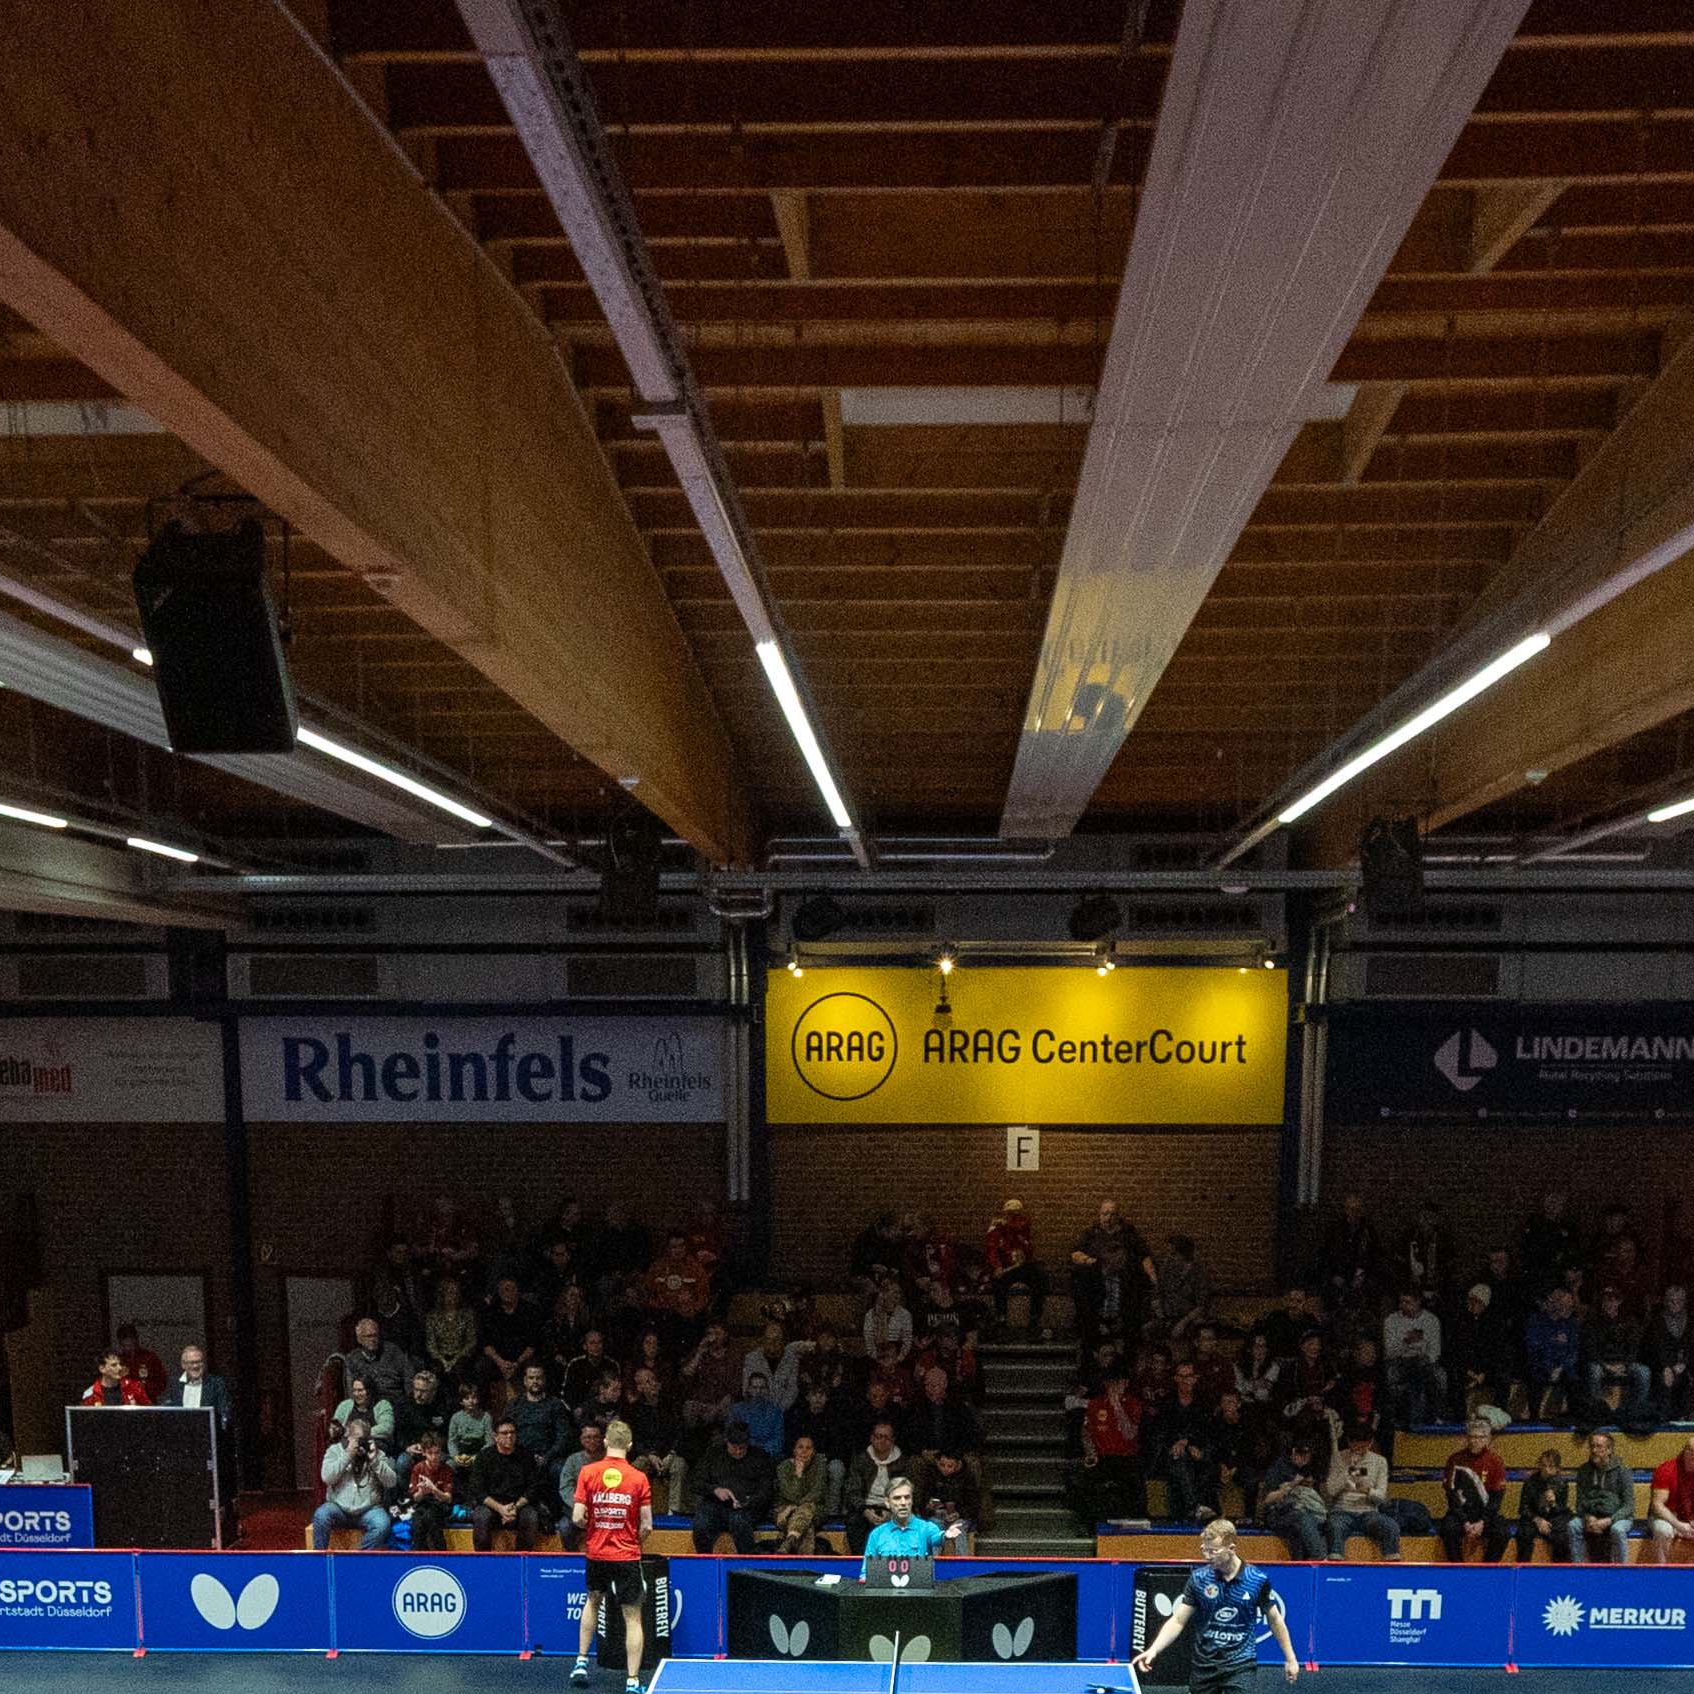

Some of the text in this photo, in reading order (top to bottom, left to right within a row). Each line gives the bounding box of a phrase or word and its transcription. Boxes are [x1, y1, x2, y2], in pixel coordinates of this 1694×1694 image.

[805, 1030, 886, 1063] ARAG
[924, 1028, 1247, 1064] ARAG CenterCourt
[282, 1032, 612, 1102] Rheinfels
[629, 1071, 712, 1090] Rheinfels
[1017, 1136, 1033, 1167] F
[15, 1532, 72, 1543] Düsseldorf
[47, 1605, 113, 1618] Düsseldorf
[403, 1592, 456, 1613] ARAG
[656, 1576, 671, 1638] BUTTERFLY
[1132, 1589, 1148, 1653] BUTTERFLY
[1589, 1607, 1687, 1626] MERKUR
[1390, 1628, 1428, 1637] Düsseldorf
